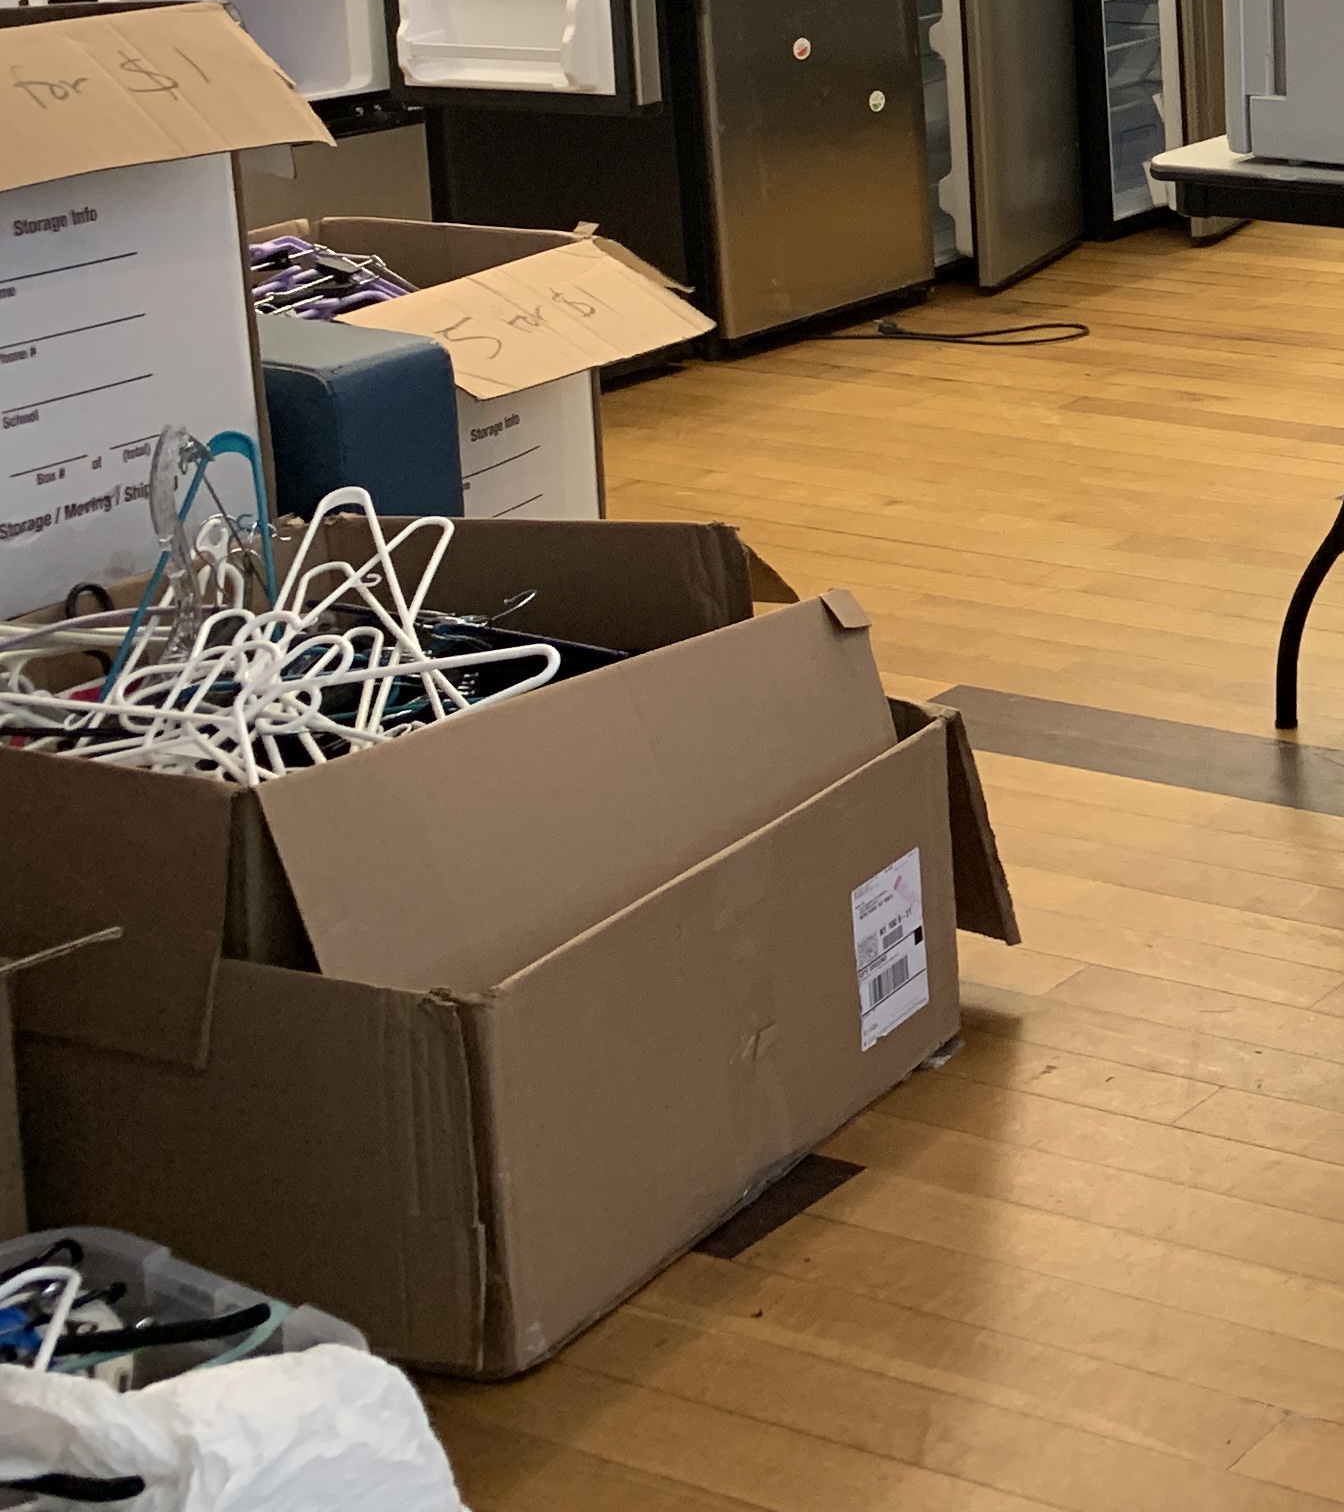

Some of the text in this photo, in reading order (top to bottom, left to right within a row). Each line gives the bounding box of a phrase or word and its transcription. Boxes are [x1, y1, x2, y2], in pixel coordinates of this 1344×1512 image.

[10, 64, 89, 110] for
[13, 206, 99, 237] Storage Info
[434, 316, 503, 360] 5
[3, 409, 40, 430] School
[470, 421, 504, 442] Storage
[36, 472, 57, 486] Box
[0, 514, 53, 541] Storage
[64, 494, 113, 521] Moving
